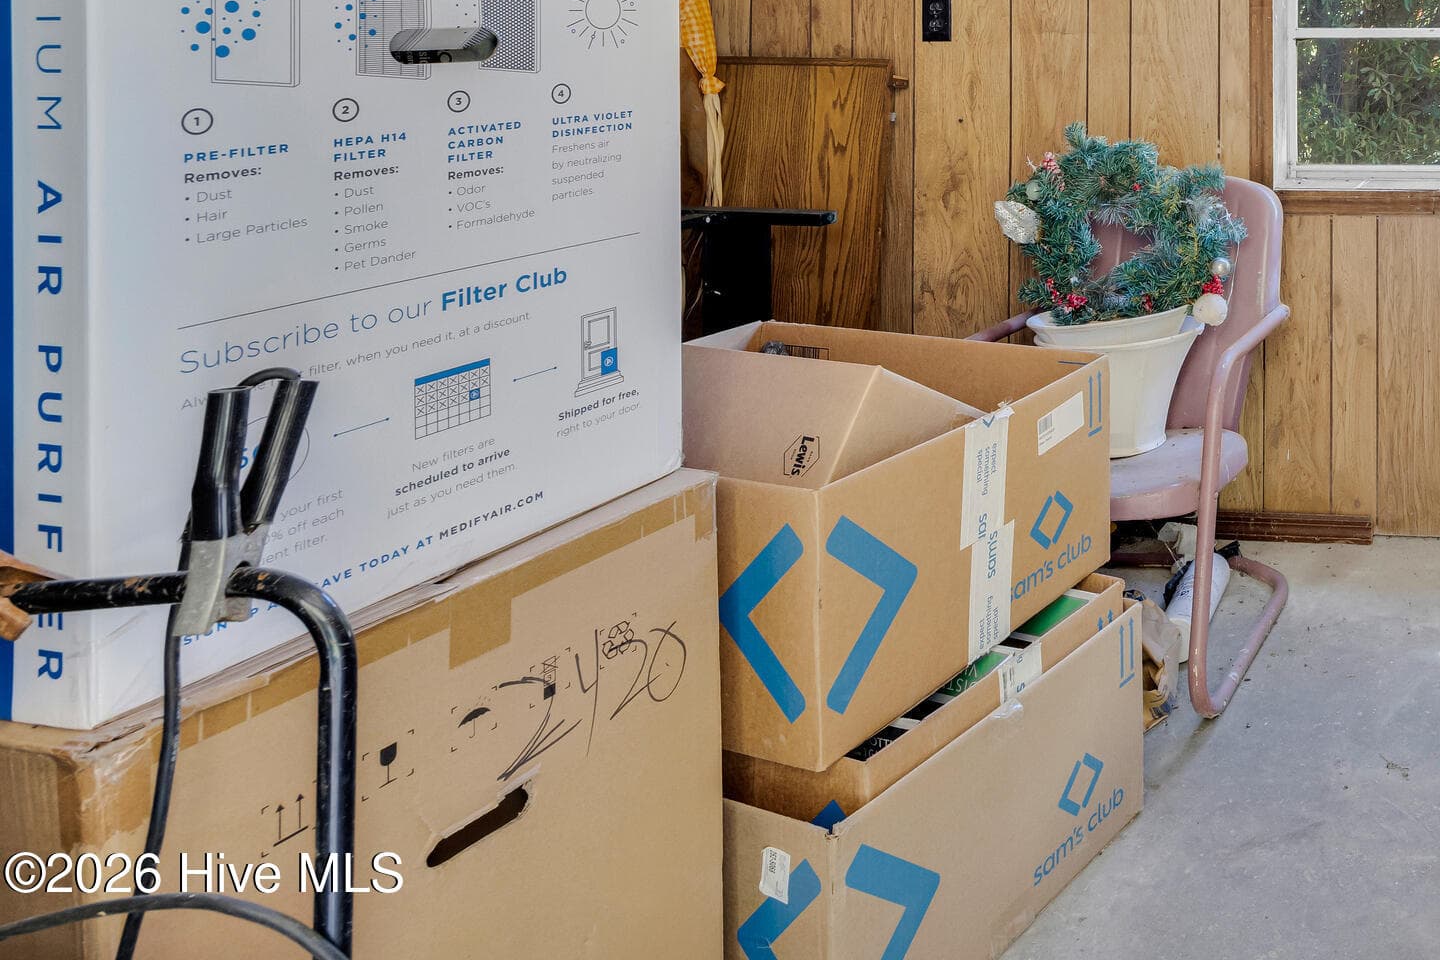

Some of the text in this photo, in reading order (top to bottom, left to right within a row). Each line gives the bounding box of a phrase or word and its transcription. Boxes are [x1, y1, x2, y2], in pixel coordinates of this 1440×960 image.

[552, 110, 633, 126] ULTRA VIOLET
[448, 121, 522, 137] ACTIVATED
[552, 123, 632, 138] DISINFECTION
[333, 132, 407, 148] HEPA H14
[448, 136, 504, 150] CARBON
[552, 139, 610, 154] Freshens air
[183, 143, 289, 164] PRE-FILTER
[333, 148, 387, 163] FILTER
[448, 150, 493, 164] FILTER
[552, 152, 622, 170] by neutralizing
[184, 166, 262, 184] Removes:
[333, 165, 399, 181] Removes:
[447, 166, 504, 181] Removes:
[552, 170, 605, 186] suspended
[196, 189, 233, 203] Dust
[344, 185, 375, 199] Dust
[456, 184, 486, 197] Odor
[196, 209, 228, 223] Hair
[344, 202, 384, 217] Pollen
[344, 219, 389, 235] Smoke
[456, 208, 536, 231] Formaldehyde
[36, 181, 64, 296] AIR
[196, 217, 308, 244] Large Particles
[344, 237, 387, 253] Germs
[344, 249, 416, 272] Pet Dander
[180, 267, 567, 374] Subscribe to our Filter Club
[346, 351, 381, 367] when
[385, 344, 408, 359] you
[412, 333, 442, 349] need
[458, 326, 470, 338] at
[558, 400, 600, 421] Shipped
[602, 396, 616, 407] for
[556, 423, 580, 438] right
[582, 419, 593, 428] to
[594, 411, 616, 425] your
[411, 437, 496, 473] New filters are
[791, 436, 815, 476] Lewis
[395, 448, 511, 497] scheduled to arrive
[280, 488, 344, 521] your first
[387, 501, 409, 520] just
[413, 497, 428, 508] as
[430, 487, 452, 504] you
[455, 474, 484, 491] need
[36, 345, 64, 680] PURIFER
[287, 507, 345, 536] off each
[314, 568, 352, 588] AVE
[359, 544, 410, 572] TODAY
[415, 535, 433, 550] AT
[439, 490, 544, 541] MEDIFYAIR.COM
[1057, 533, 1093, 571] club
[1033, 787, 1124, 887] sam's club
